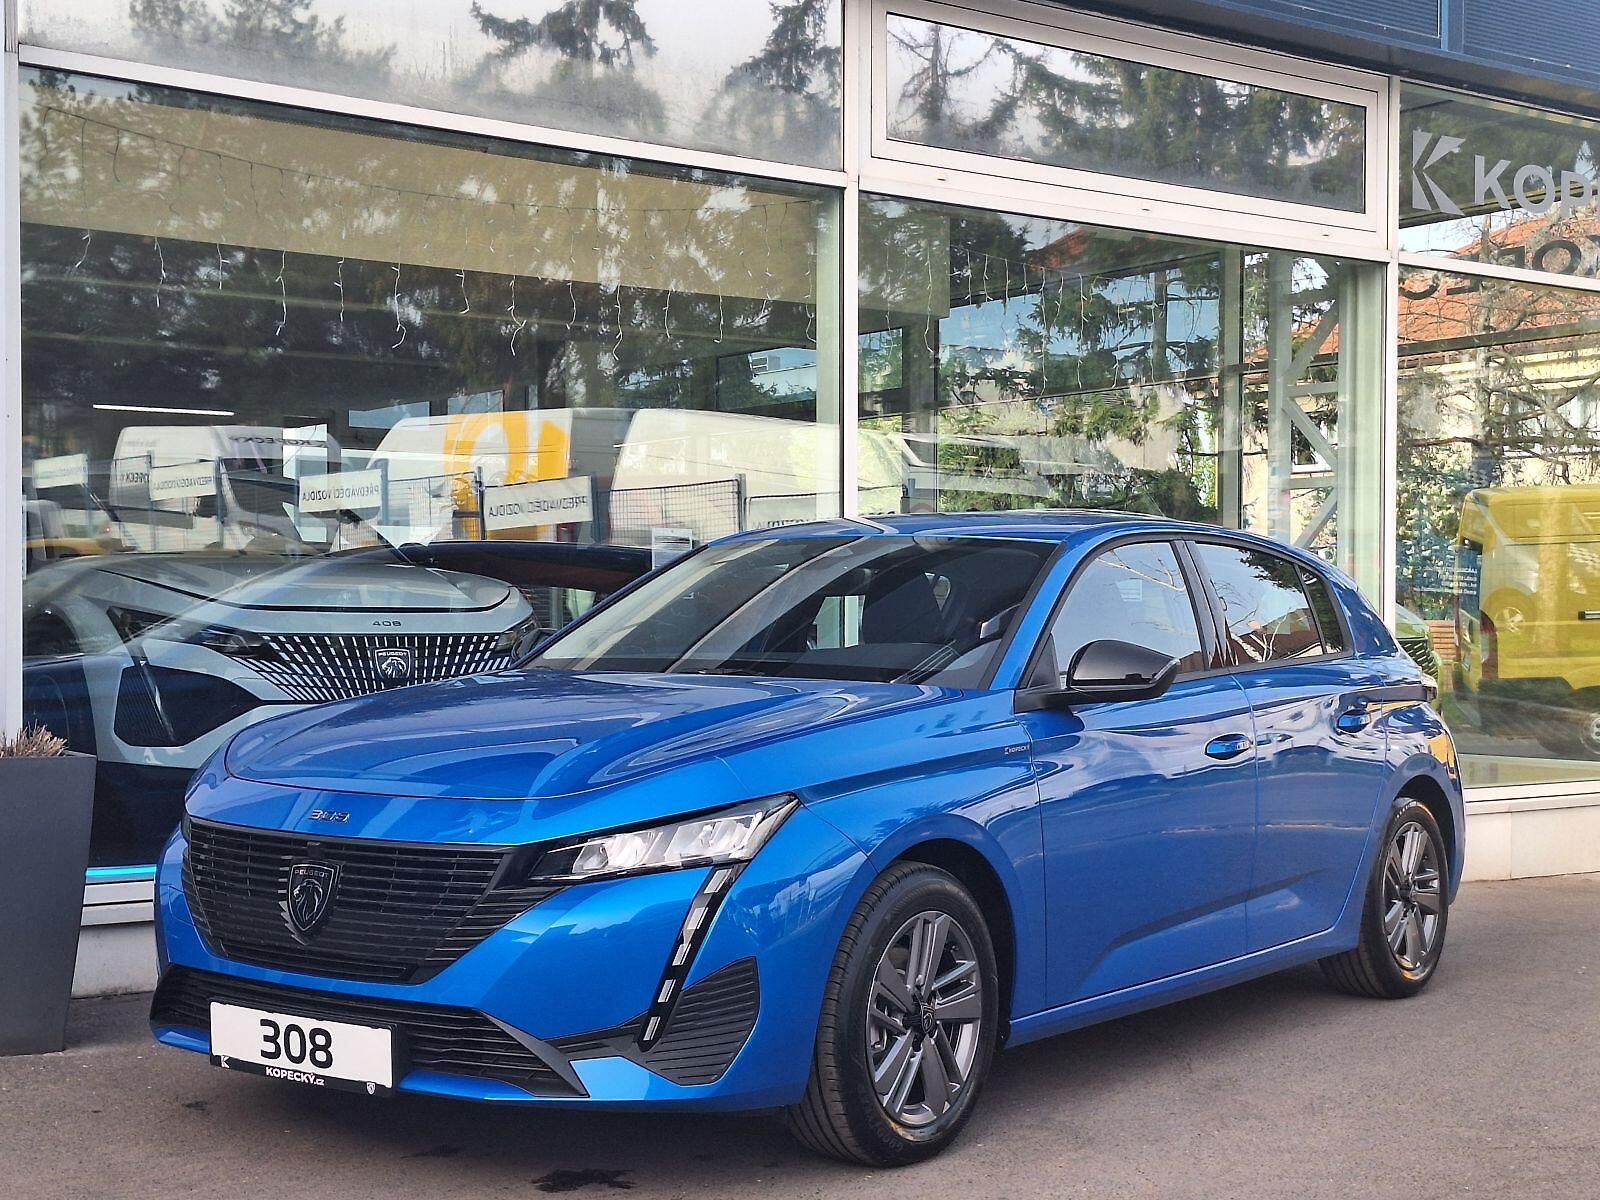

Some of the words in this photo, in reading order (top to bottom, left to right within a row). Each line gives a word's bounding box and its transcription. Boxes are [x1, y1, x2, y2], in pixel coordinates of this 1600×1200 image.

[1473, 154, 1600, 219] KOP
[294, 868, 329, 878] PEUGEOT
[259, 1018, 334, 1069] 308
[265, 1066, 325, 1087] KOPECKÝ.cz
